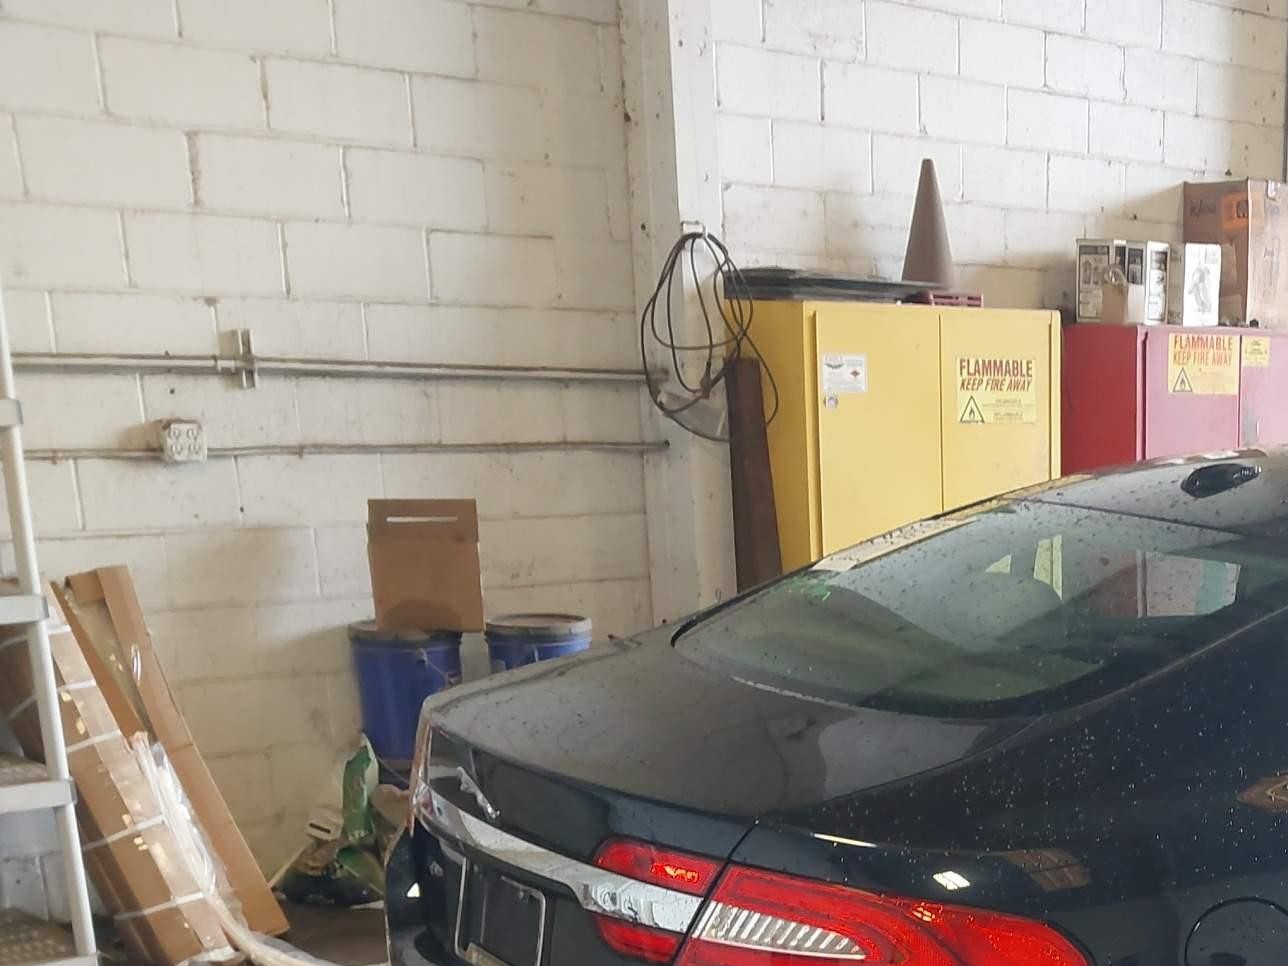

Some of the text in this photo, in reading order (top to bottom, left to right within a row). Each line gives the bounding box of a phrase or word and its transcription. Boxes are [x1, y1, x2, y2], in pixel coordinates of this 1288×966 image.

[1173, 335, 1233, 351] FLAMMABLE
[1173, 350, 1192, 364] KEEP
[1193, 351, 1210, 366] FIRE
[1211, 351, 1233, 367] AWAY
[959, 358, 1033, 378] FLAMMABLE
[959, 378, 1032, 393] KEEP FIRE AWAY
